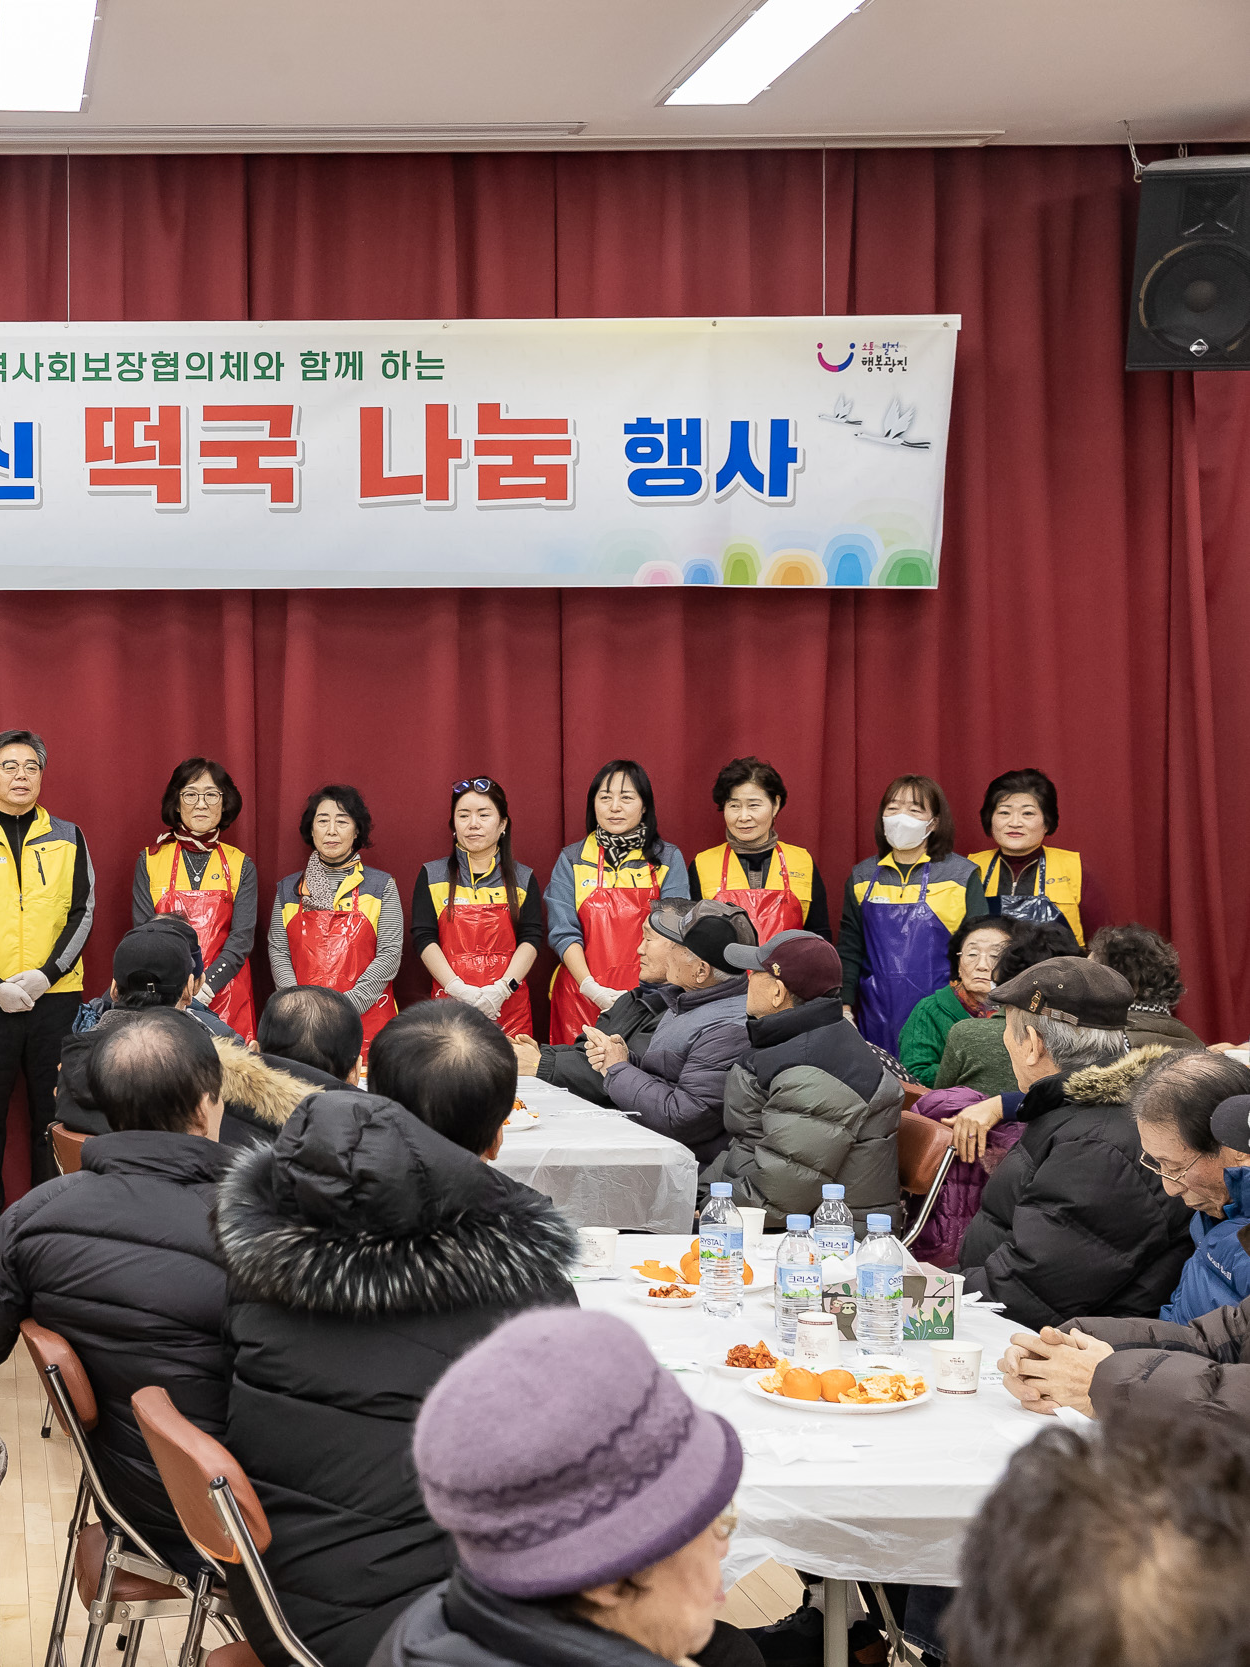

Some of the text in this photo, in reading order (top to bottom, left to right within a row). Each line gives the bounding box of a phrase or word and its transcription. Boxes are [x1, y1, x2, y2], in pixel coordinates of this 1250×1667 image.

[299, 350, 364, 382] 함께
[380, 350, 445, 382] 하는
[861, 354, 908, 373] 행복광진
[84, 404, 299, 506] 떡국
[358, 402, 574, 504] 나눔
[623, 416, 800, 499] 행사
[818, 1240, 849, 1249] 크리스탈
[787, 1274, 820, 1284] 크리스탈
